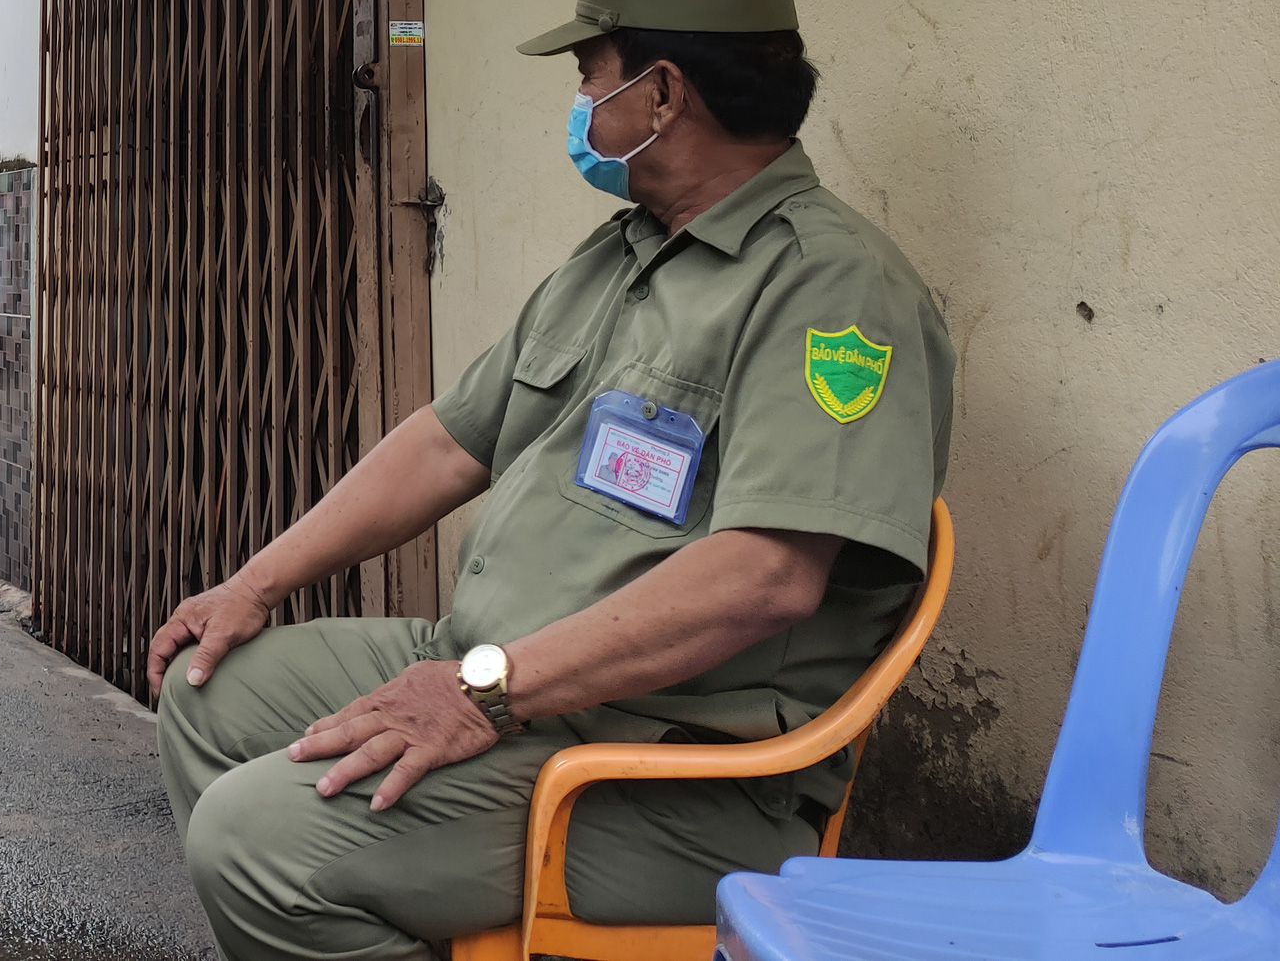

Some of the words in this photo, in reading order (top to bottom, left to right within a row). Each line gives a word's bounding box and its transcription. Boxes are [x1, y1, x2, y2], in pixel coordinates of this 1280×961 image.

[811, 342, 832, 361] BẢO
[832, 345, 845, 364] VỆ
[845, 348, 866, 368] DÂN
[865, 356, 885, 375] PHỐ
